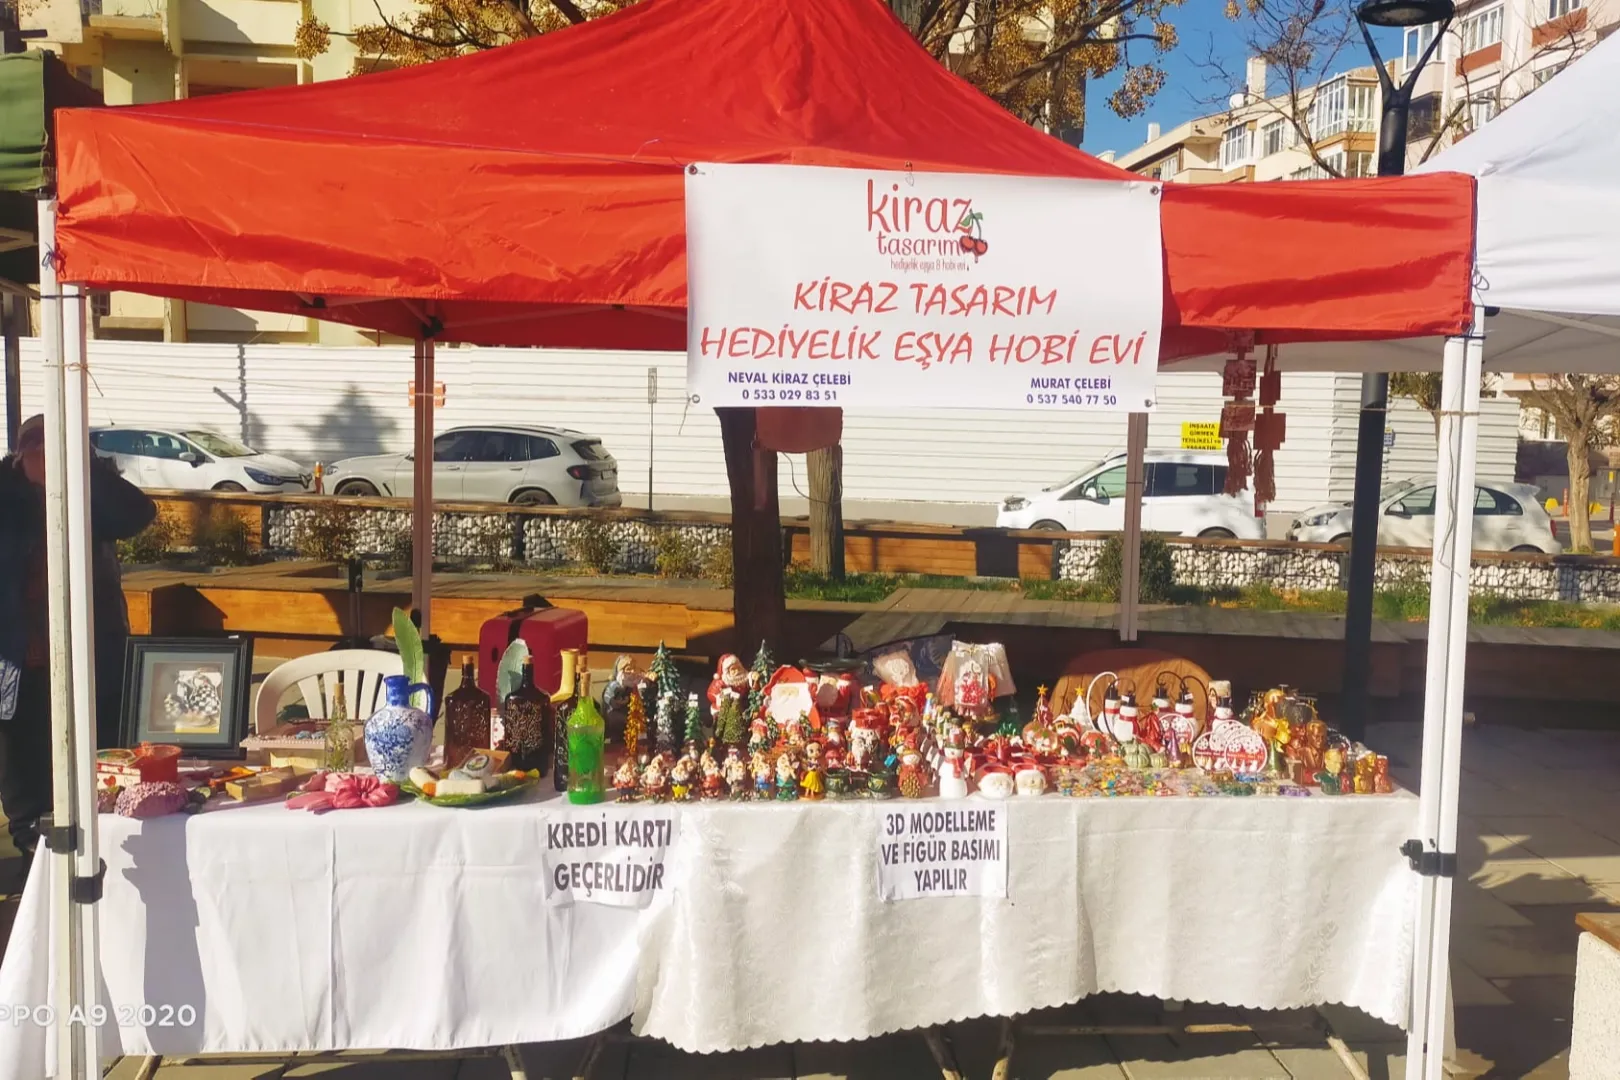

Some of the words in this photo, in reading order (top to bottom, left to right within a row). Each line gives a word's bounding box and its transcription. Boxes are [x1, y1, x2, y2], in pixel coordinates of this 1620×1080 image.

[867, 178, 973, 233] kiraz
[876, 230, 961, 256] tasarım
[793, 276, 899, 315] KİRAZ
[909, 282, 1057, 318] TASARIM
[700, 323, 882, 360] HEDİYELİK
[894, 331, 973, 370] EŞYA
[988, 329, 1080, 365] HOBİ
[1088, 330, 1148, 365] EVİ
[727, 371, 769, 384] NEVAL
[772, 370, 809, 385] KİRAZ
[812, 371, 852, 388] ÇELEBİ
[1030, 377, 1071, 390] MURAT
[1074, 375, 1112, 392] ÇELEBİ
[742, 389, 750, 400] 0
[753, 389, 776, 401] 533
[779, 389, 802, 401] 029
[805, 390, 820, 401] 83
[824, 390, 837, 401] 51
[1026, 393, 1034, 404] 0
[1037, 394, 1058, 405] 537
[1061, 394, 1082, 405] 540
[1085, 395, 1099, 405] 77
[1103, 395, 1117, 406] 50
[547, 812, 607, 850] KREDİ
[615, 819, 672, 848] KARTI
[886, 813, 905, 836] 3D
[910, 810, 996, 834] MODELLEME
[881, 842, 899, 865] VE
[903, 835, 947, 863] FİGÜR
[951, 839, 1000, 861] BASIMI
[554, 855, 665, 897] GEÇERLİDİR
[914, 868, 968, 892] YAPILIR
